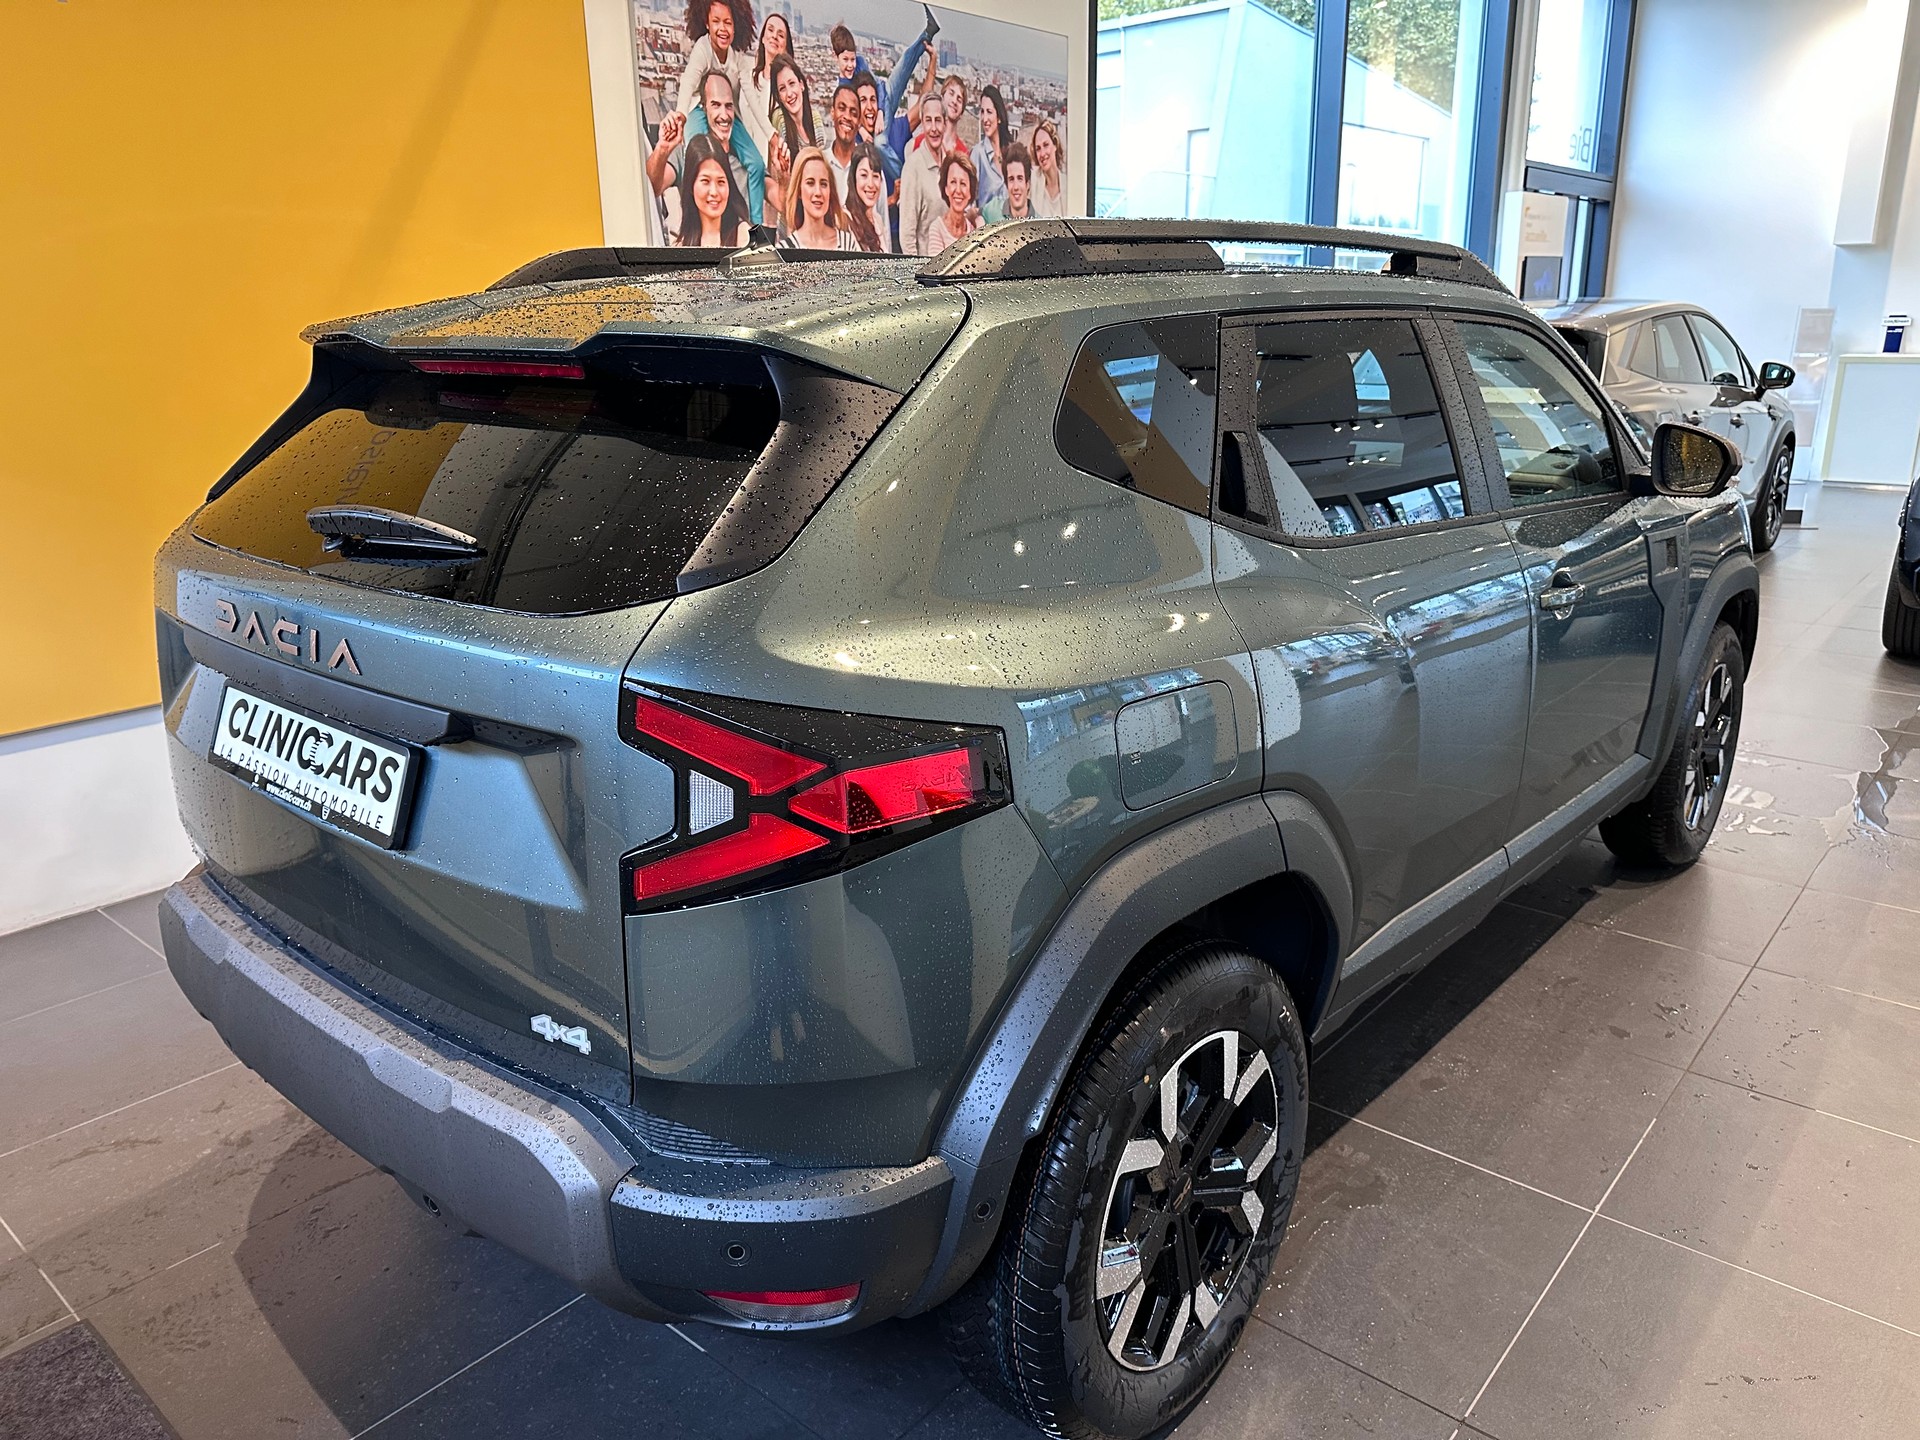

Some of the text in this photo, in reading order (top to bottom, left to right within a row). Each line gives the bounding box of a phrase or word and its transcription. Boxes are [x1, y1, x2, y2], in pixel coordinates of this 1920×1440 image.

[215, 598, 363, 676] DACIA
[220, 745, 384, 830] LA PASSION AUTOMOBILE
[530, 1013, 592, 1056] 4x4
